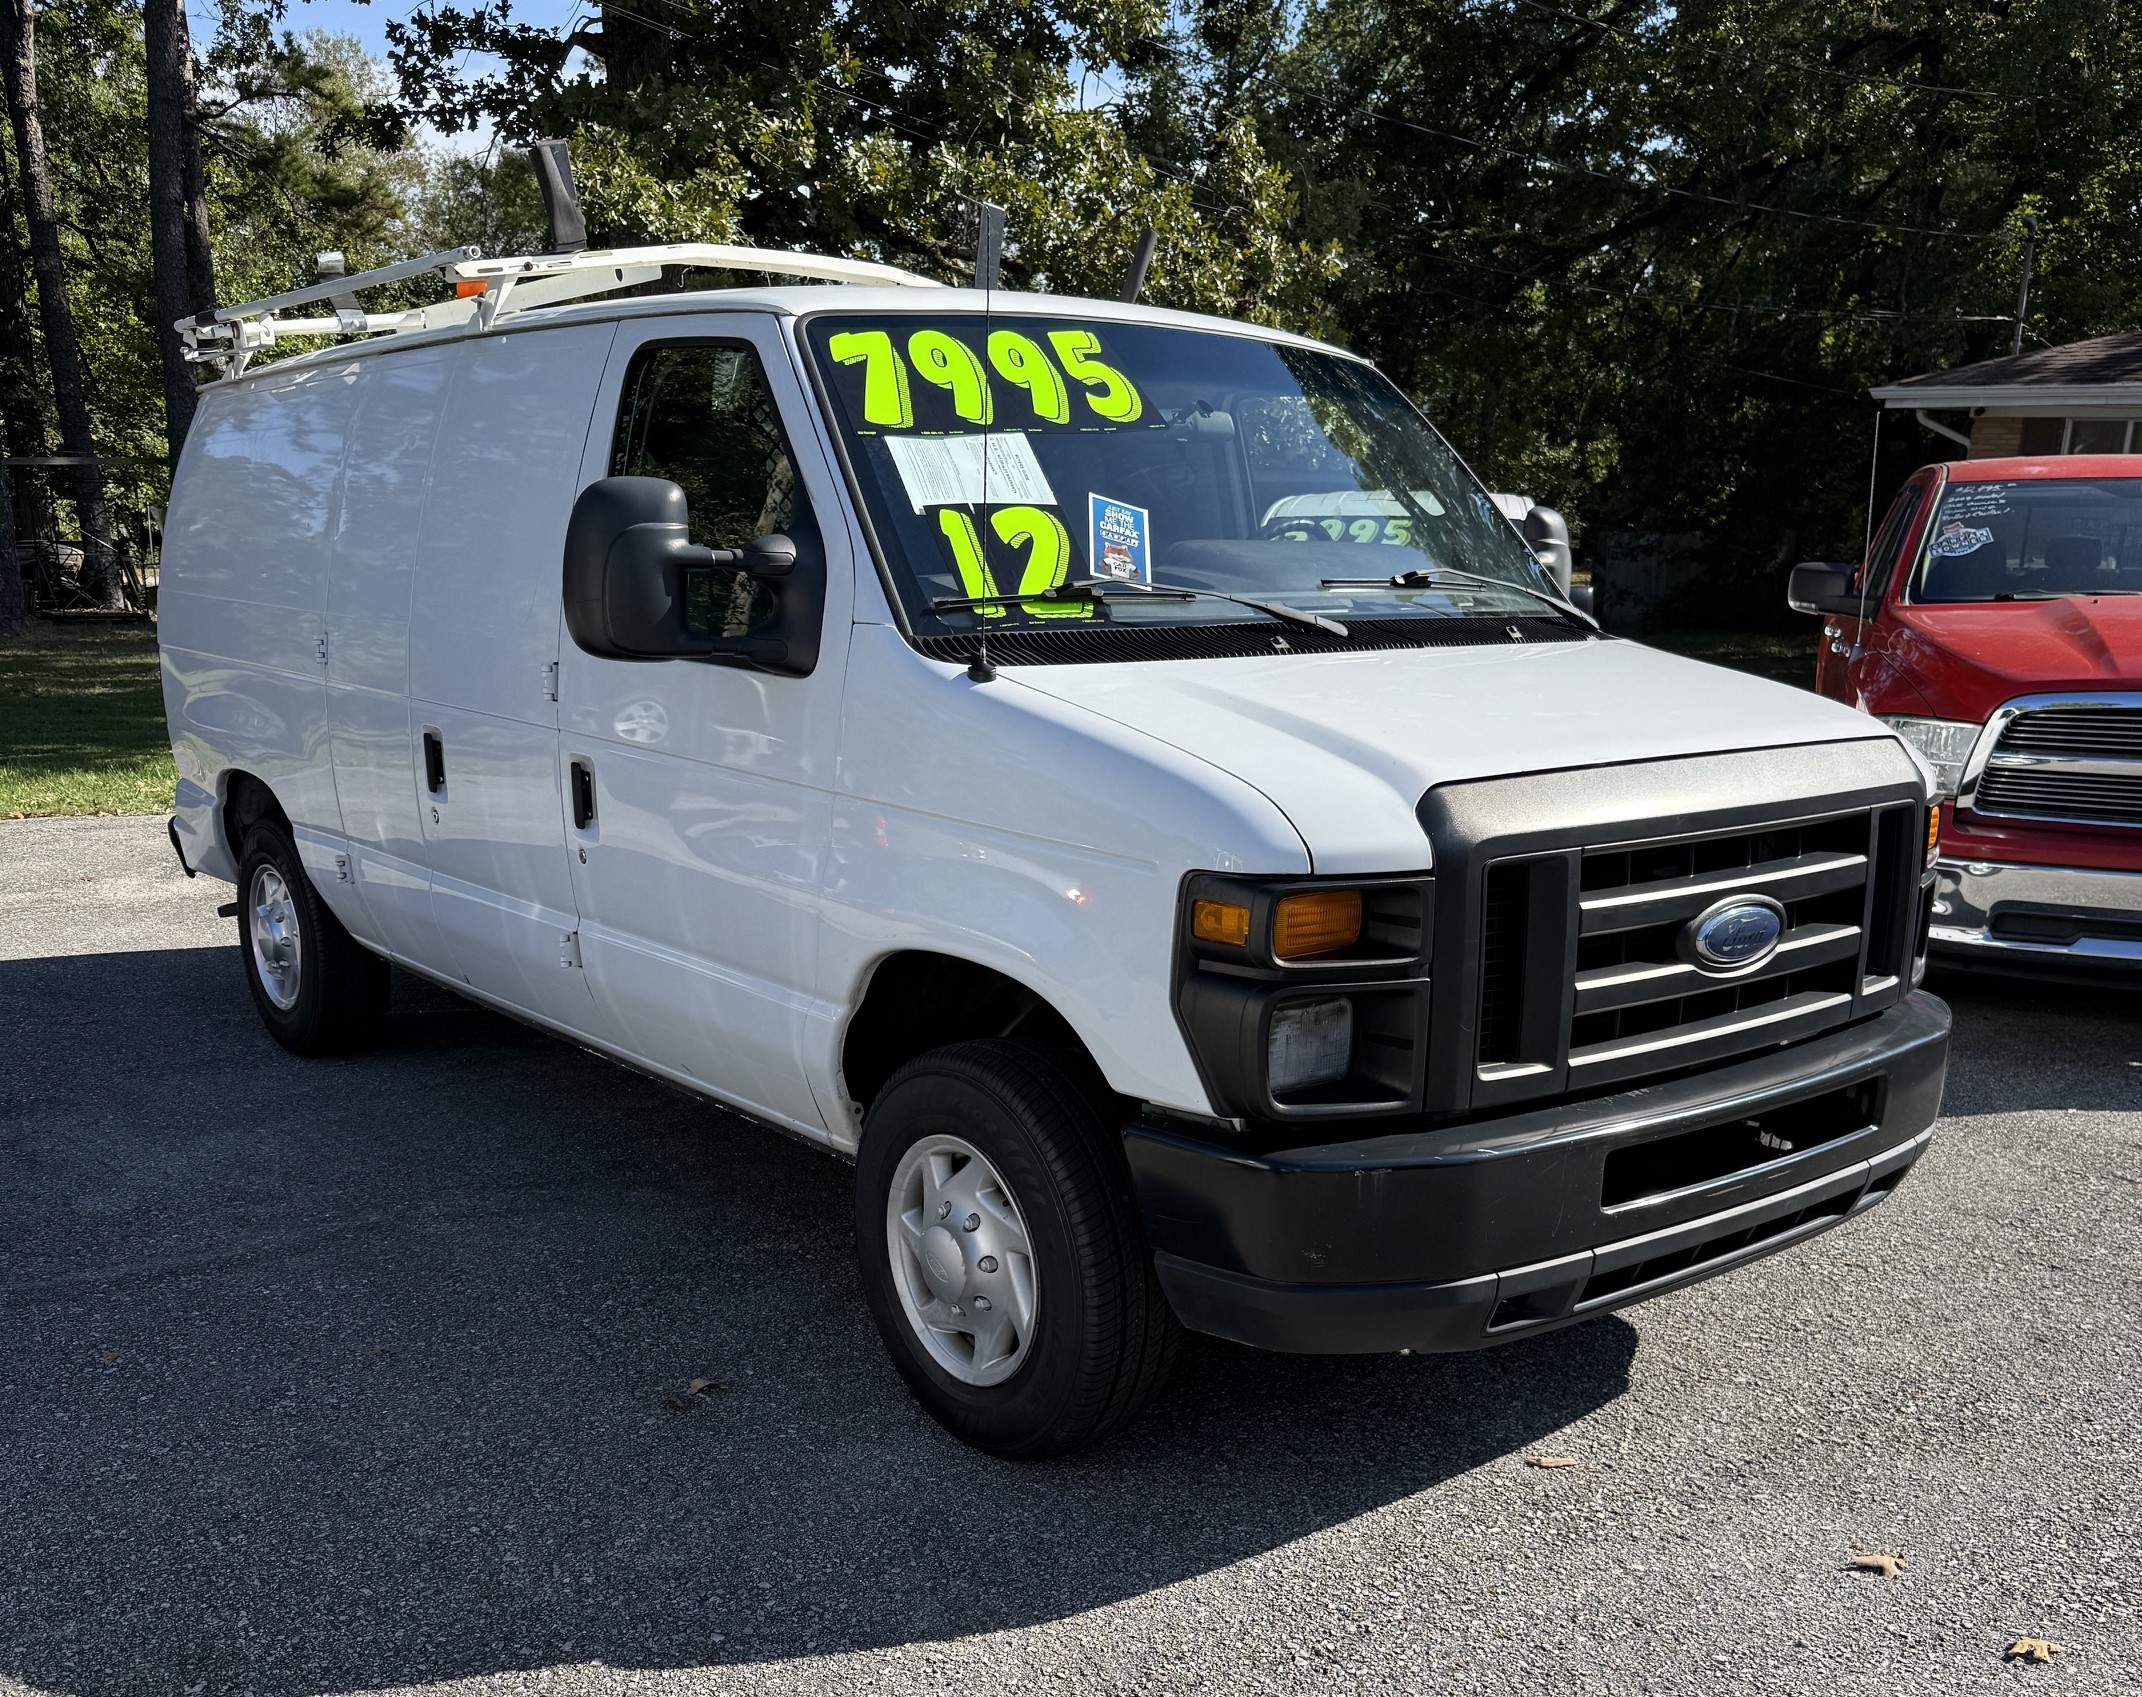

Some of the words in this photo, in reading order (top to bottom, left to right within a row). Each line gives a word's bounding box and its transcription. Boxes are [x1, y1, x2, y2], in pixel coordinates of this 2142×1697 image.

[829, 329, 1143, 429] 7995
[1105, 509, 1134, 523] SHOW
[1105, 516, 1117, 526] ME
[1120, 520, 1135, 532] THE
[1099, 521, 1139, 539] CARFAX
[939, 506, 1093, 619] 12
